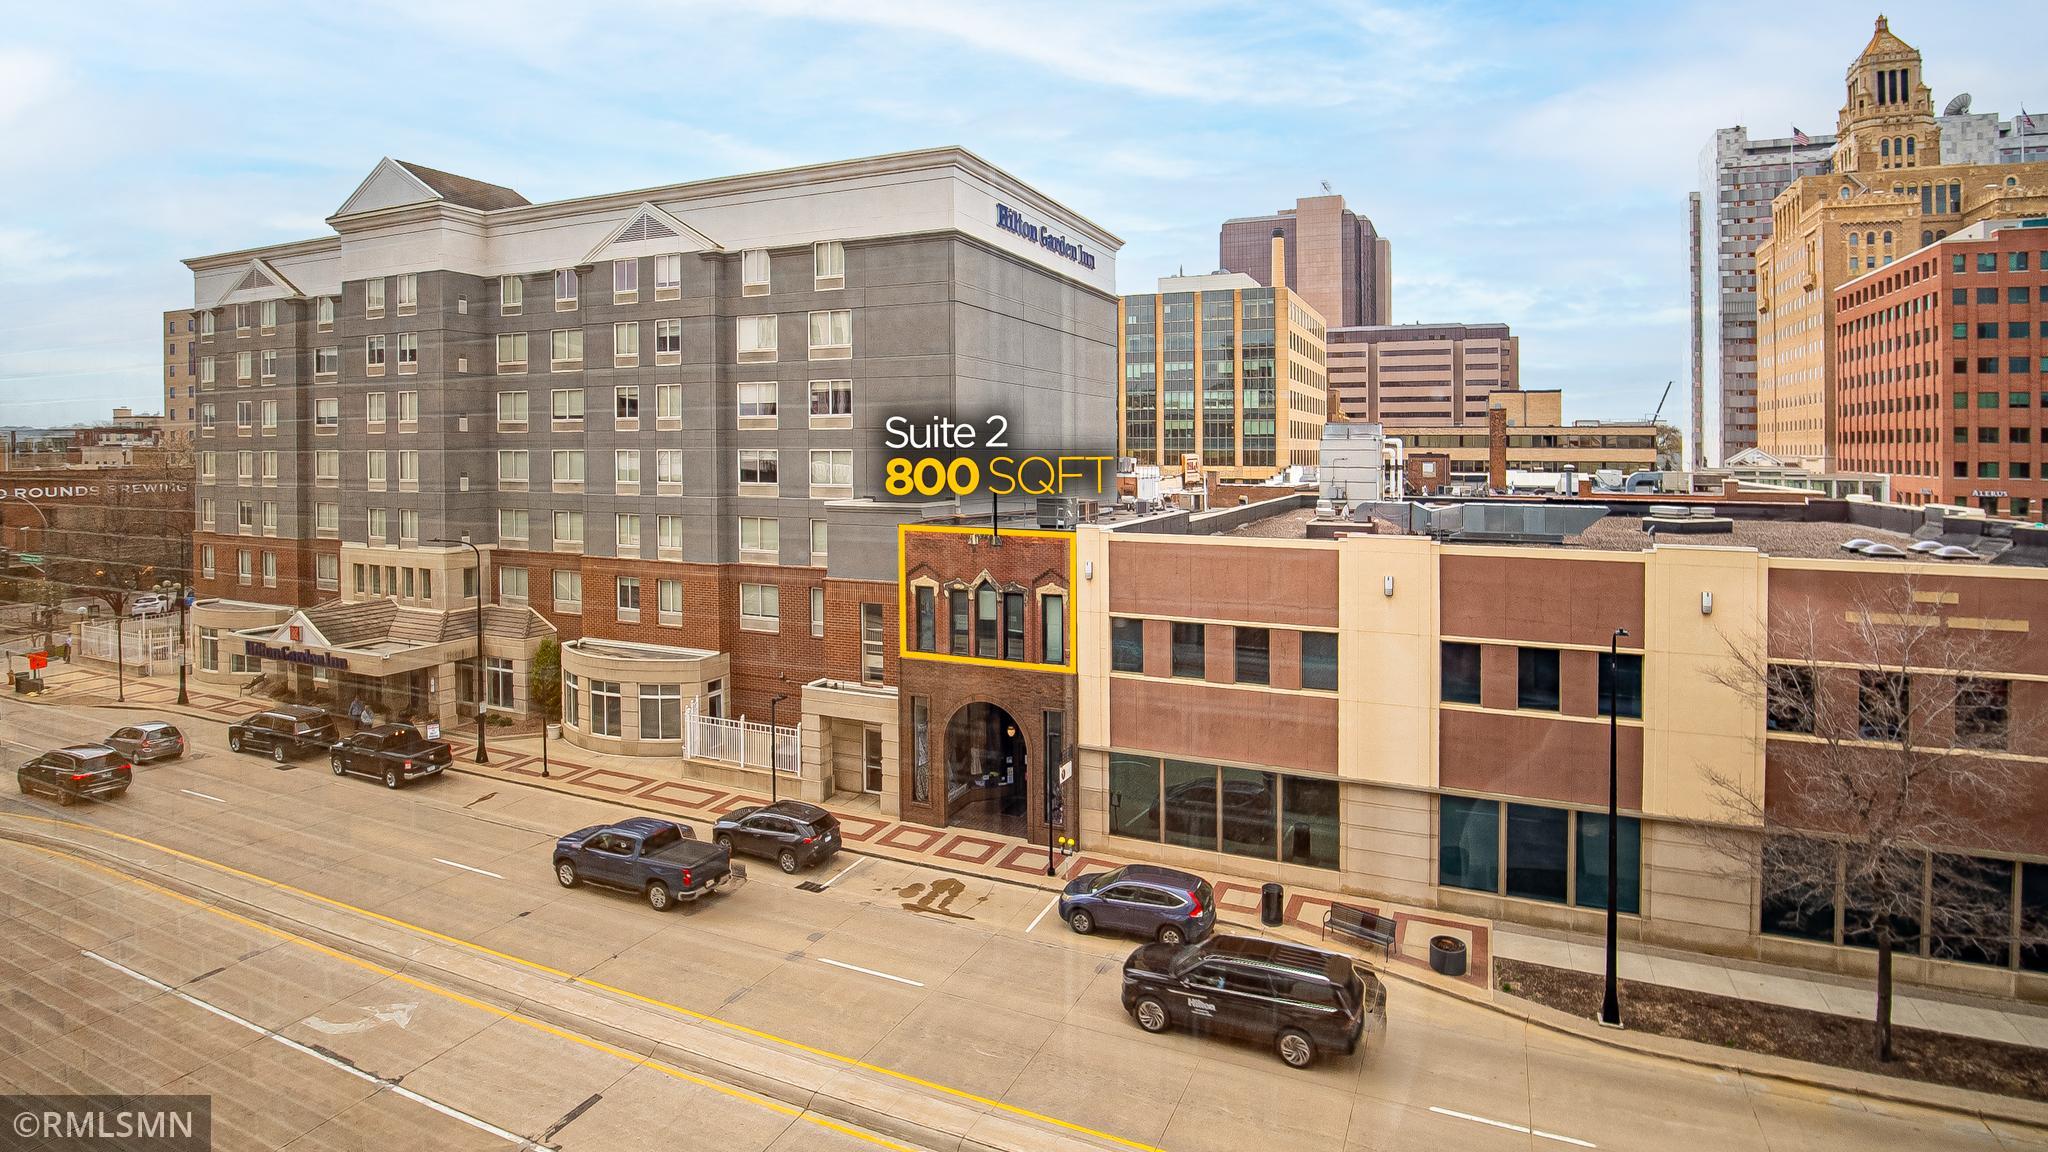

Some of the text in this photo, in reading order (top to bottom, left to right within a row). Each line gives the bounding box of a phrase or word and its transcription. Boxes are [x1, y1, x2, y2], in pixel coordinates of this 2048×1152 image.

[996, 203, 1096, 270] Hilton Garden Inn
[14, 486, 99, 498] ROUNDS
